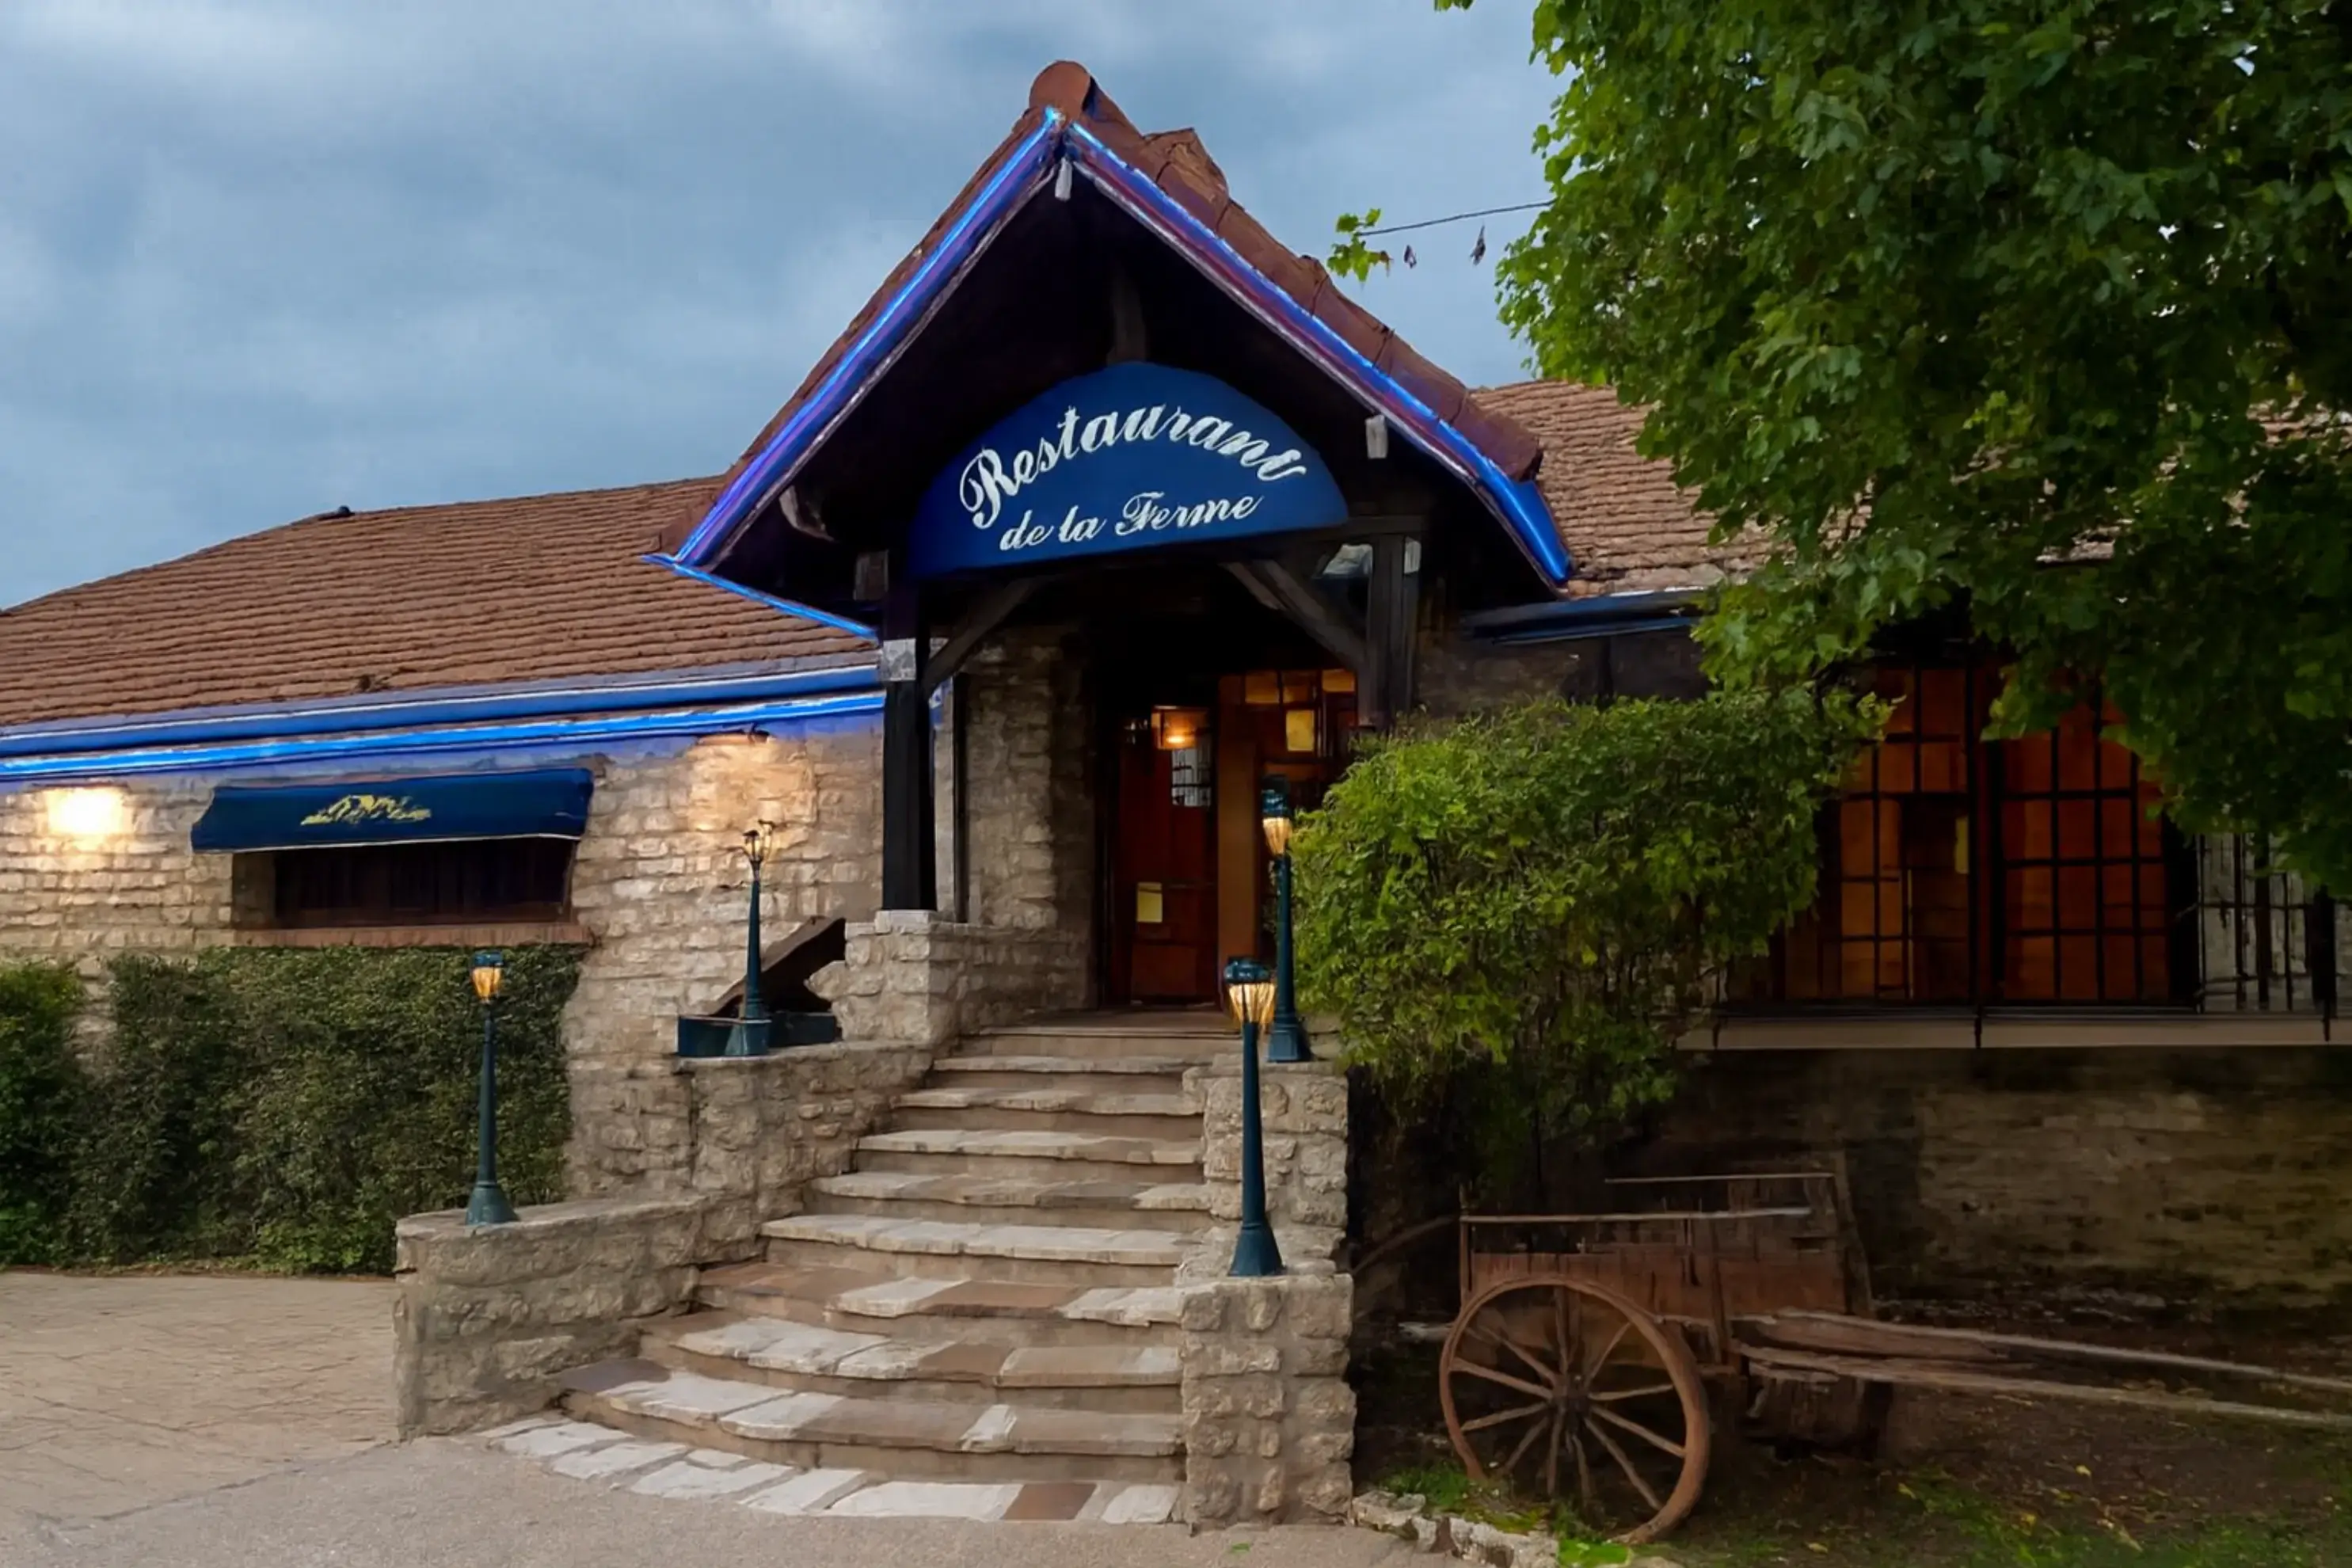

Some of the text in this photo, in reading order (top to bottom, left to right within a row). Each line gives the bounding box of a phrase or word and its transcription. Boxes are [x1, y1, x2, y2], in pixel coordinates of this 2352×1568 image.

[959, 405, 1307, 529] Restaurant
[999, 491, 1262, 551] de la Ferme
